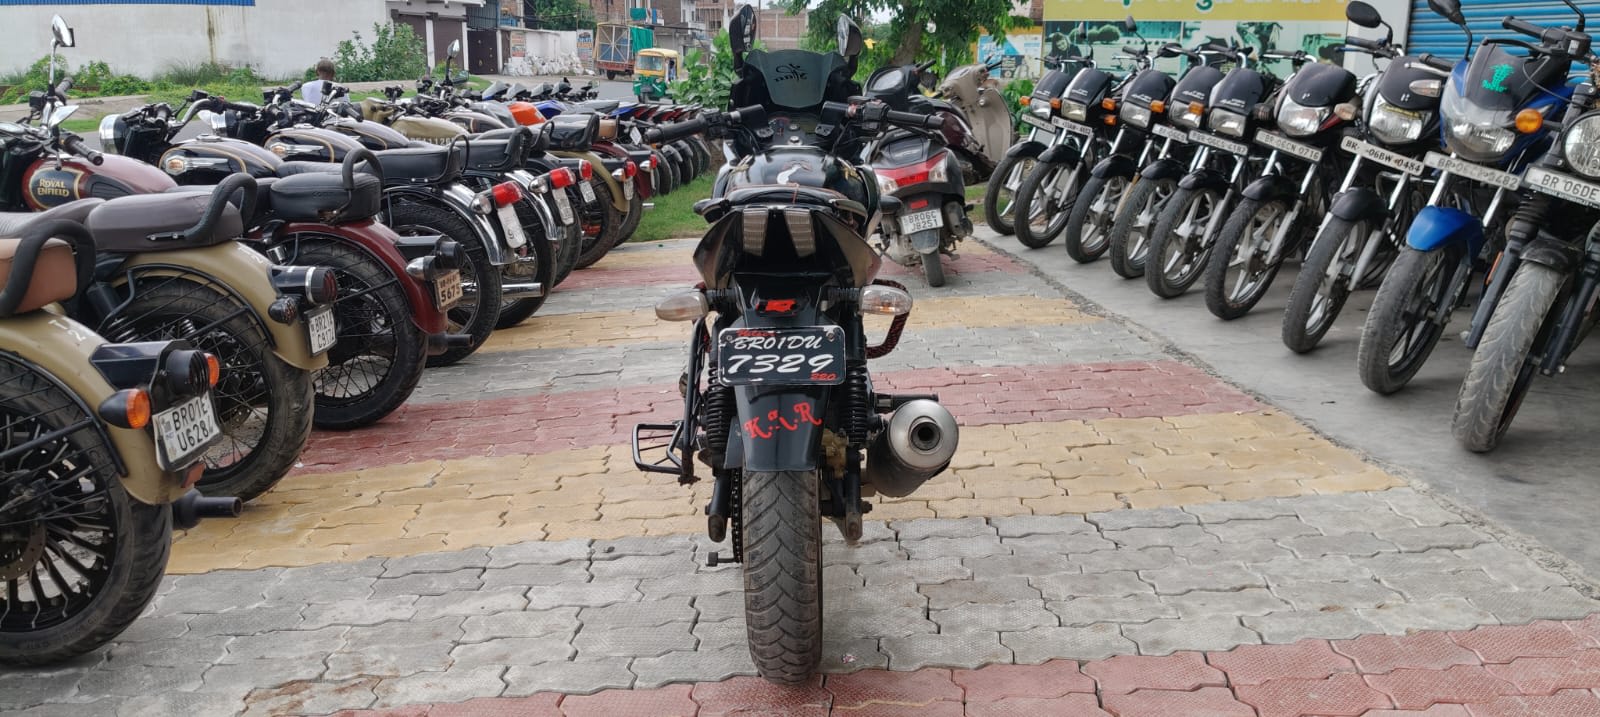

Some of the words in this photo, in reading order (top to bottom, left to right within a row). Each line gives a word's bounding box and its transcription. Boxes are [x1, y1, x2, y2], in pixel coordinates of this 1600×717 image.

[40, 178, 66, 188] ROYAL
[37, 187, 70, 197] ENFIELD
[440, 282, 460, 303] 5675
[727, 353, 834, 375] 7329
[810, 372, 837, 380] 220
